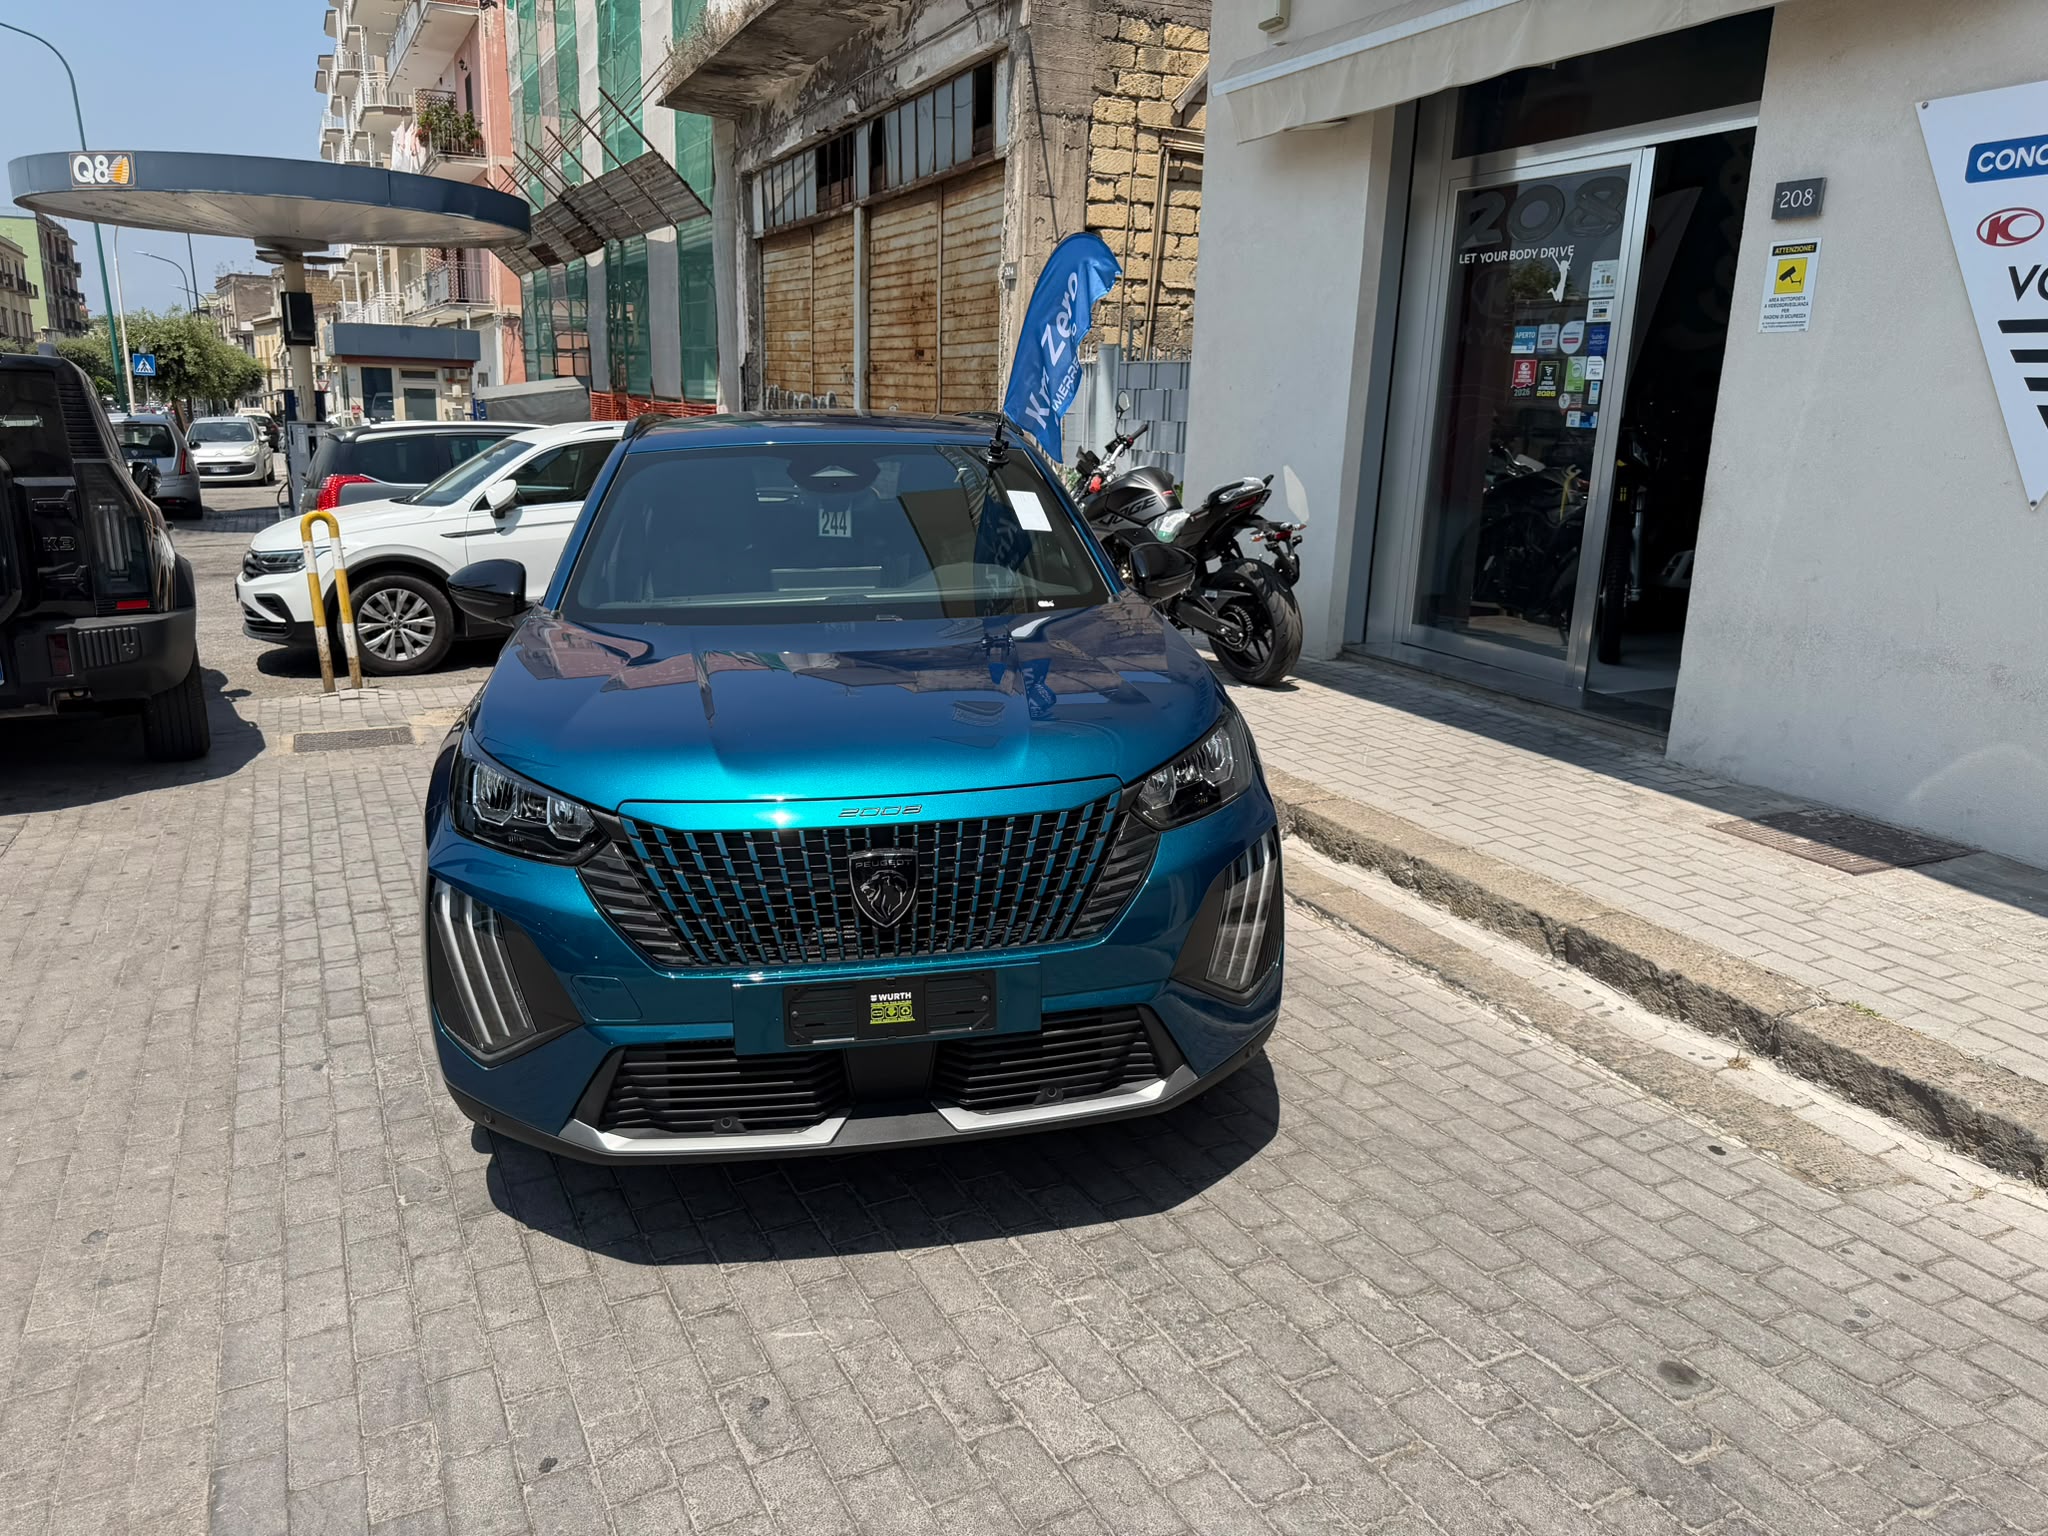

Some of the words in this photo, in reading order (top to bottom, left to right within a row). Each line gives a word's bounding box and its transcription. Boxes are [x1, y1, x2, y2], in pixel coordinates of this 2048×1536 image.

[73, 155, 110, 184] Q8
[1780, 188, 1813, 208] 208
[1462, 176, 1629, 248] 208
[1459, 253, 1477, 264] LET
[1480, 251, 1508, 264] YOUR
[1509, 248, 1539, 260] BODY
[1540, 245, 1575, 258] DRIVE
[1041, 271, 1078, 367] Zero
[1515, 331, 1536, 339] APERTO
[822, 511, 847, 535] 244
[838, 804, 923, 818] 2008
[855, 859, 913, 868] PEUGEOT
[878, 992, 912, 1001] WURTH
